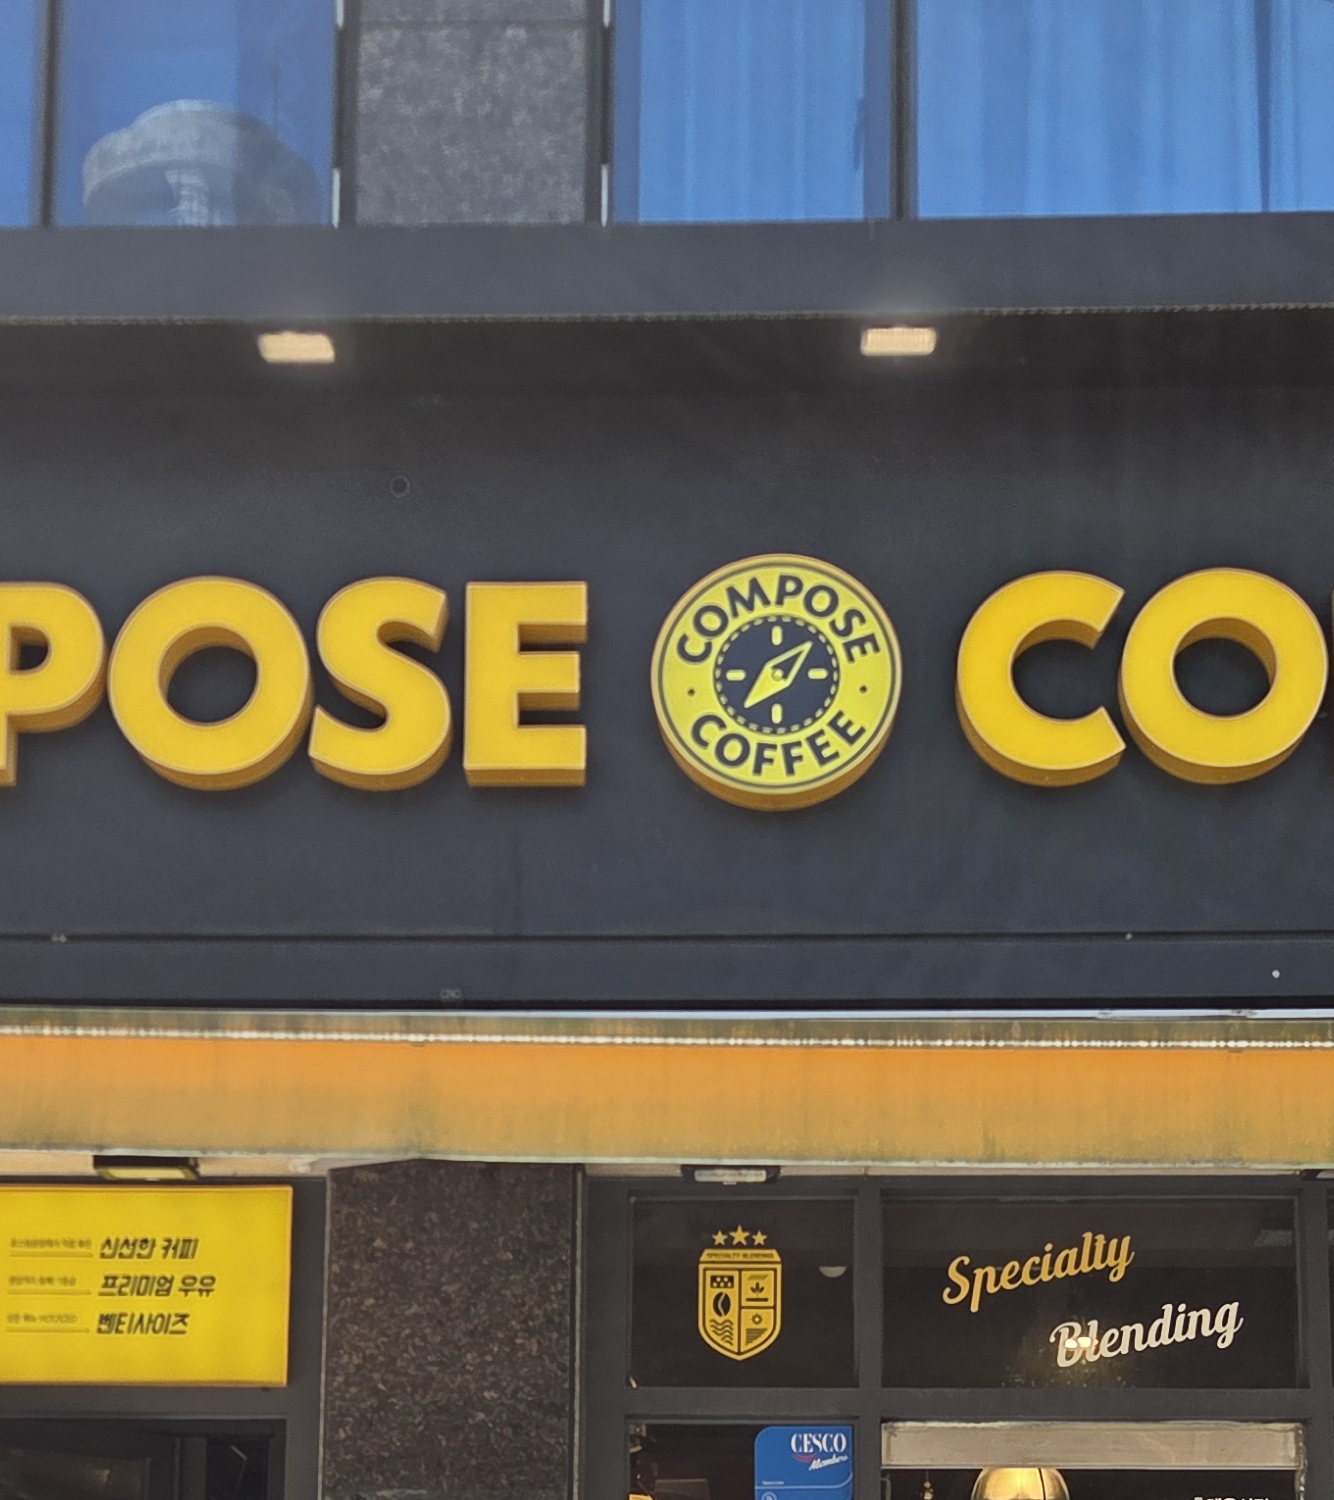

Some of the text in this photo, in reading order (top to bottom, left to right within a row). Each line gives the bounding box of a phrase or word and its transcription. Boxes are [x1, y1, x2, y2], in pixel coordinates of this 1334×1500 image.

[676, 573, 881, 664] COMPOSE
[691, 711, 867, 777] COFFEE
[99, 1237, 157, 1259] 신선한
[162, 1237, 199, 1259] 커피
[98, 1275, 175, 1297] 프리미엄
[178, 1275, 216, 1297] 우유
[942, 1232, 1135, 1313] Specialty
[97, 1312, 190, 1335] 벤티사이즈
[1049, 1301, 1244, 1367] Blending
[790, 1432, 847, 1453] CESCO
